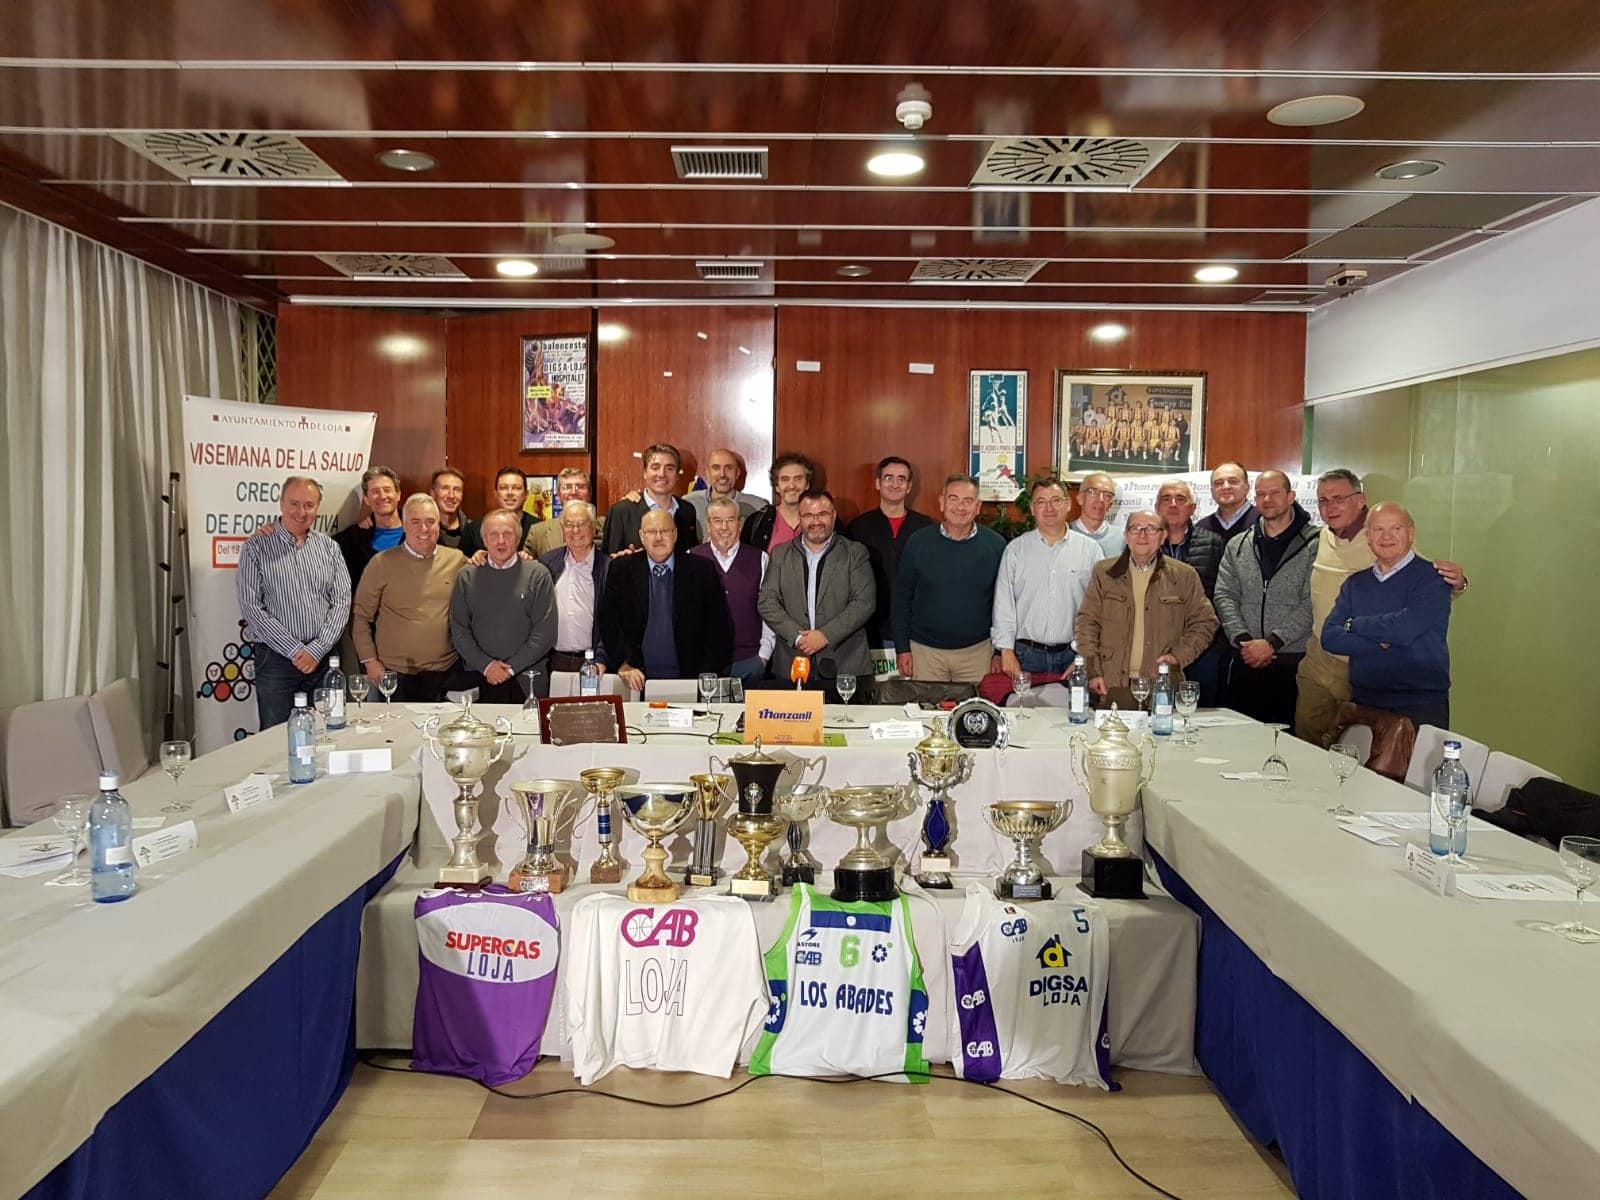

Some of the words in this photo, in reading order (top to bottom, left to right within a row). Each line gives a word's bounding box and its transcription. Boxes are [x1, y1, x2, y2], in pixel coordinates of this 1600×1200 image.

[221, 413, 296, 429] AYUNTAMIENTO
[310, 422, 321, 431] DE
[322, 423, 343, 433] LOJA
[204, 442, 271, 468] SEMANA
[276, 448, 295, 470] DE
[299, 450, 317, 470] LA
[320, 451, 364, 472] SALUD
[206, 514, 229, 534] DE
[217, 544, 230, 554] Del
[758, 709, 812, 720] Manzanil
[621, 908, 699, 948] CAB
[1000, 918, 1028, 937] CAB
[1072, 909, 1090, 933] 5
[445, 931, 541, 960] SUPERCAS
[839, 935, 861, 968] 6
[467, 951, 514, 982] LOJA
[1029, 975, 1088, 997] DIGSA
[800, 980, 828, 1008] LOS
[836, 983, 894, 1015] ABADES
[961, 990, 986, 1009] CAB
[1043, 993, 1081, 1007] LOJA
[966, 1040, 994, 1058] CAB
